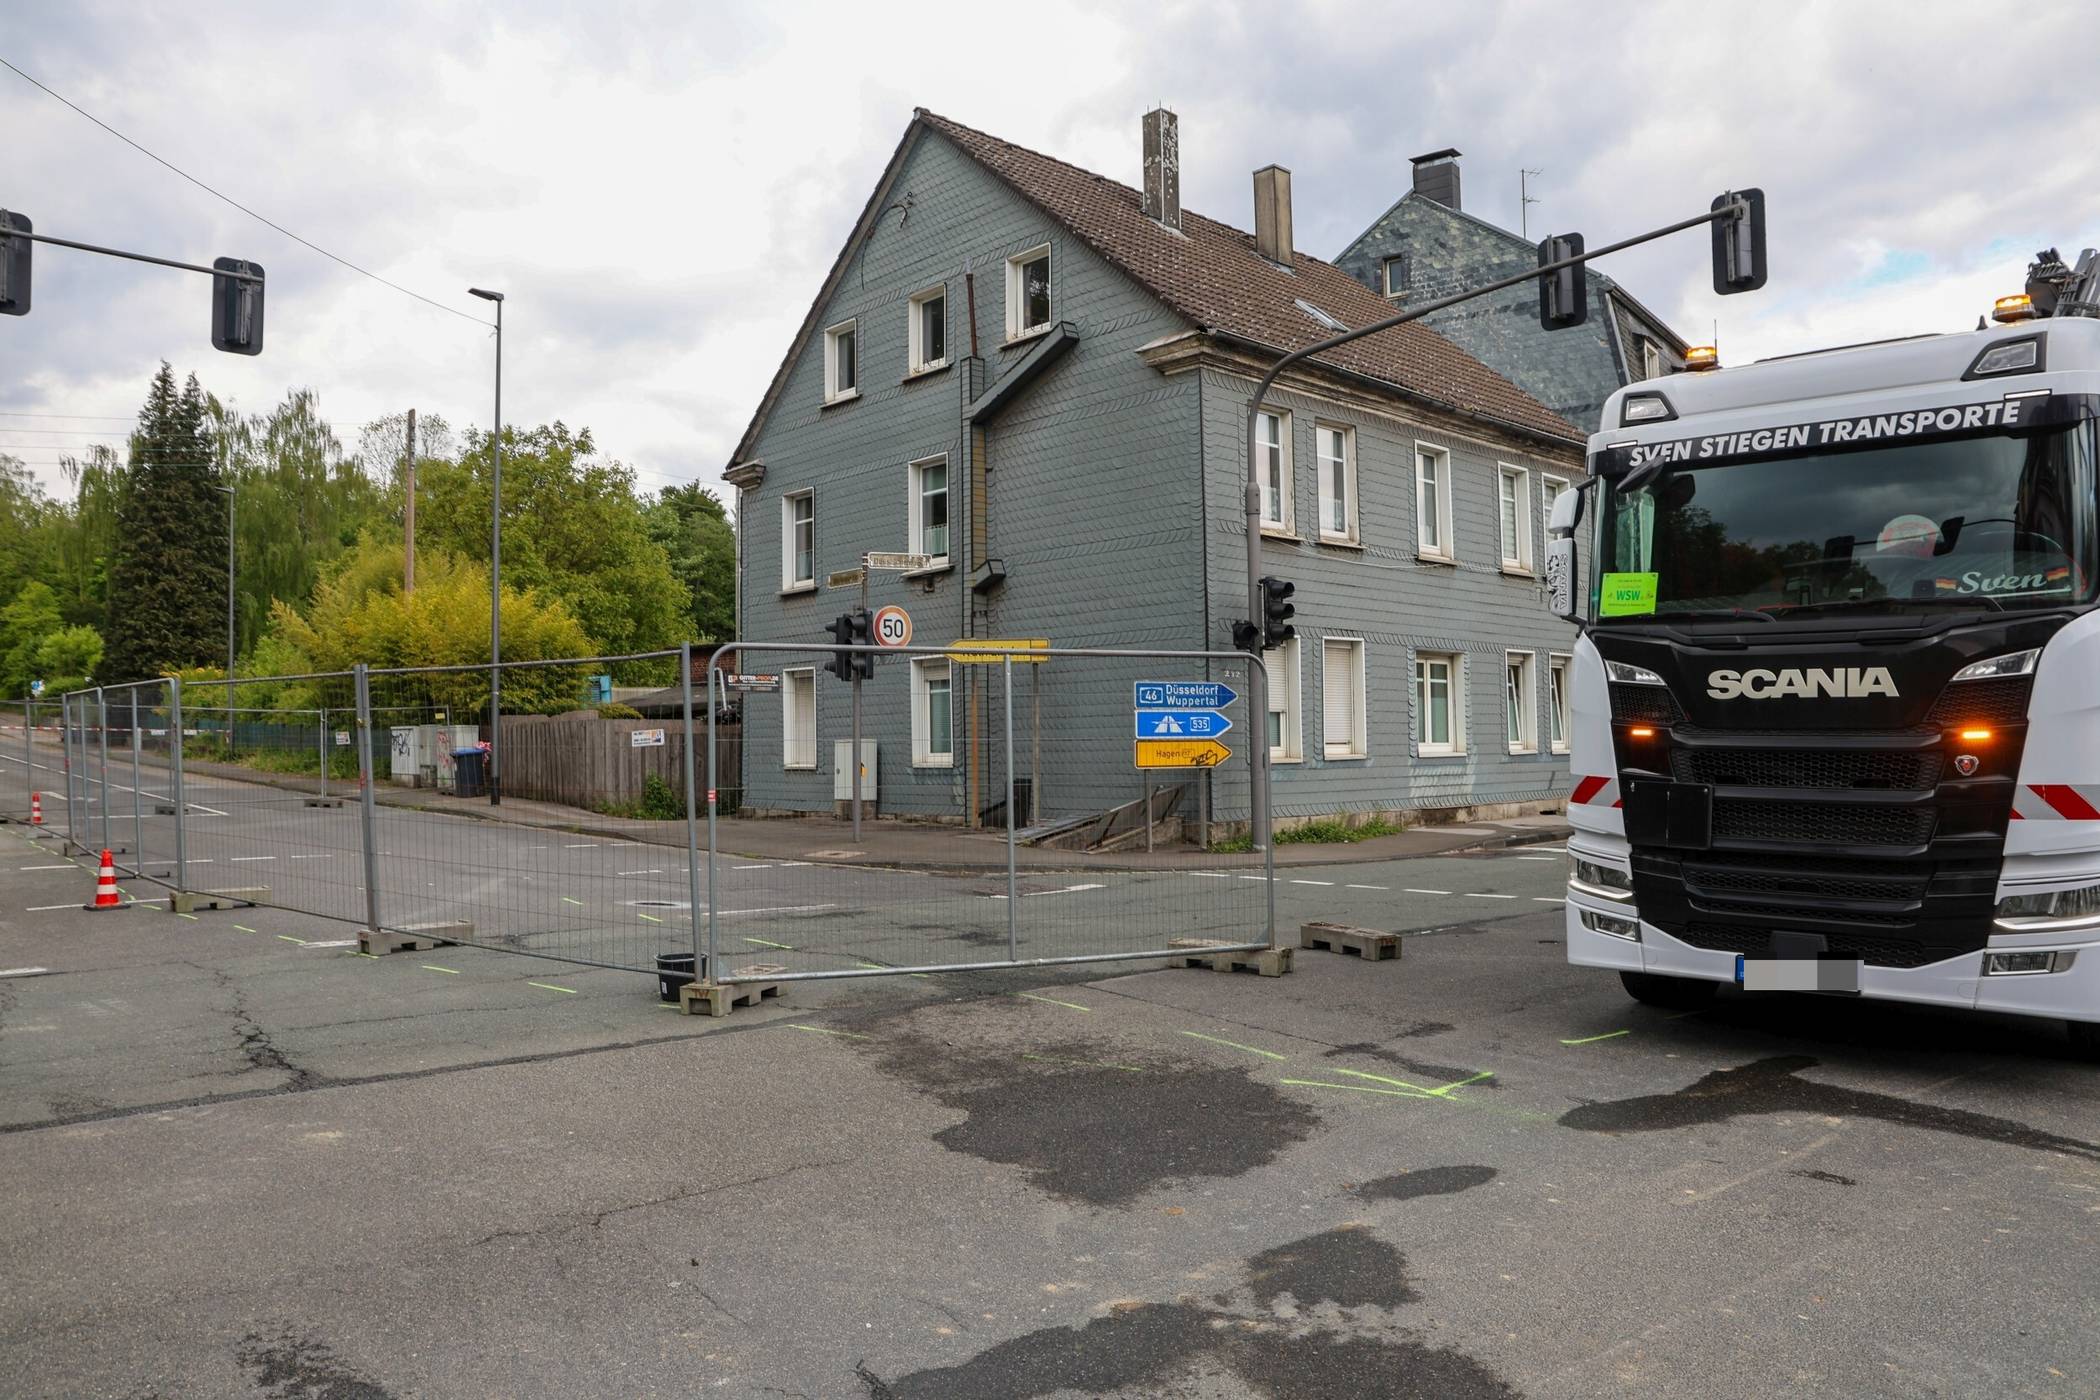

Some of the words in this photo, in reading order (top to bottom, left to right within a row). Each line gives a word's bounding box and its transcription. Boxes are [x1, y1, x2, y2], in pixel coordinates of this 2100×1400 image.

[1629, 440, 1693, 467] SVEN
[1698, 425, 1811, 458] STIEGEN
[1819, 400, 2021, 443] TRANSPORTE
[1957, 571, 2048, 594] Sven
[1616, 590, 1641, 601] WSW
[883, 619, 904, 638] 50
[1706, 667, 1900, 700] SCANIA
[1145, 690, 1158, 700] 46
[1165, 684, 1219, 695] Düsseldorf
[1166, 695, 1218, 707] Wuppertal
[1192, 720, 1208, 729] 535
[1155, 750, 1180, 759] Hagen
